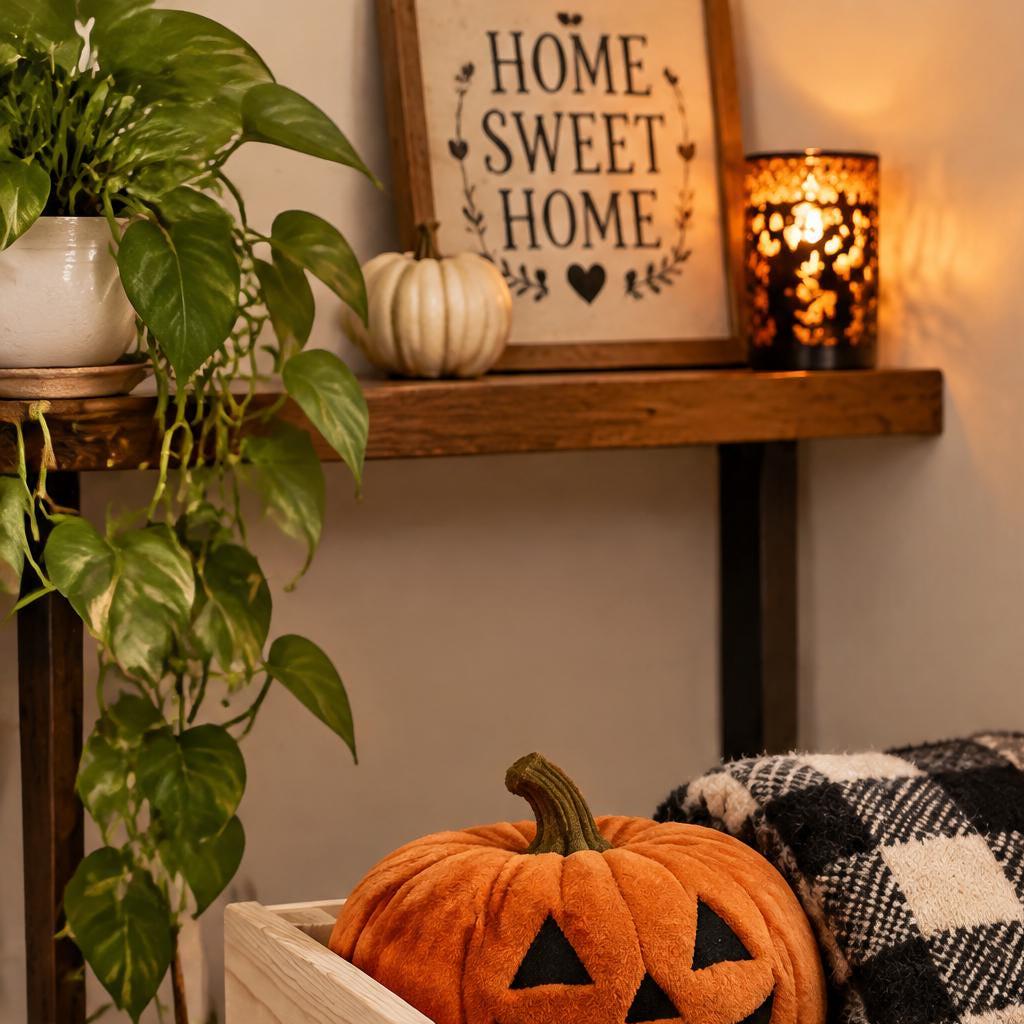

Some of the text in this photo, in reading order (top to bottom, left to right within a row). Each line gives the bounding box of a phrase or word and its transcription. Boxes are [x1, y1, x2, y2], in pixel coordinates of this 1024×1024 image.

[487, 31, 652, 97] HOME
[481, 109, 666, 175] SWEET
[499, 188, 662, 250] HOME
